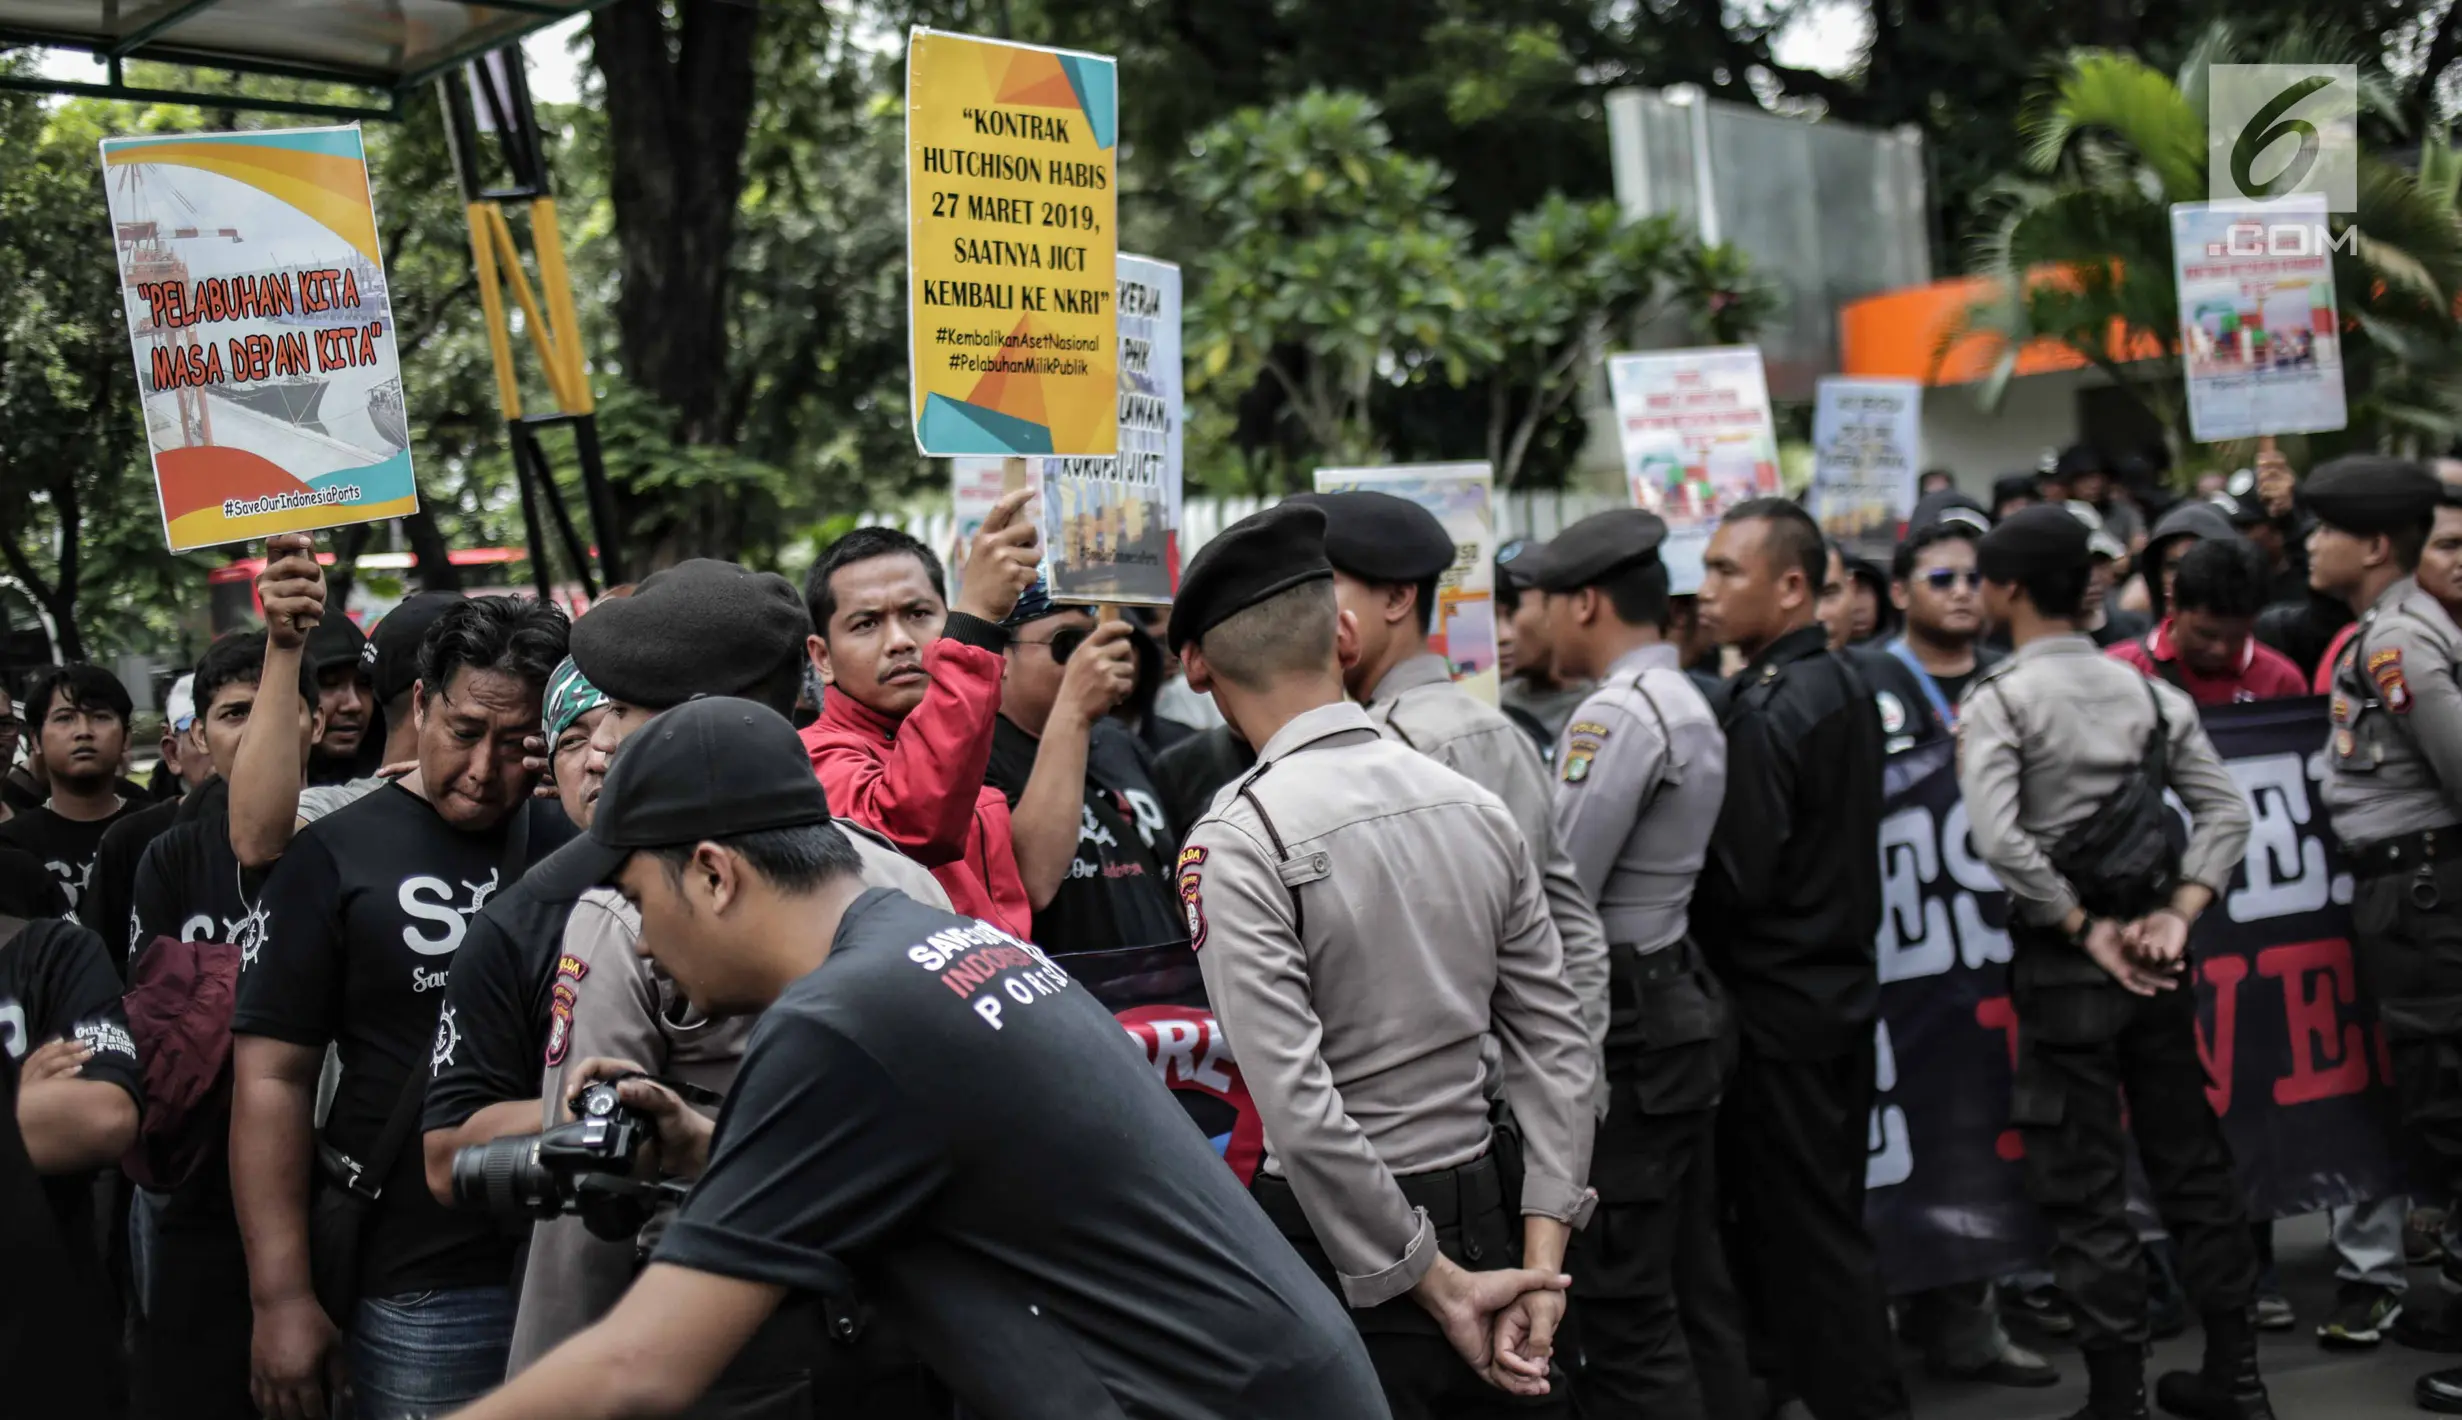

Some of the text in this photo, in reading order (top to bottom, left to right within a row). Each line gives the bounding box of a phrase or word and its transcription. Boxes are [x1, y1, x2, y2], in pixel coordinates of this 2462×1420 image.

[962, 108, 1070, 144] “KONTRAK
[923, 146, 1107, 190] HUTCHISON HABIS
[932, 190, 1101, 236] 27 MARET 2019,
[954, 236, 1088, 272] SAATNYA JICT
[138, 267, 361, 329] "PELABUHAN KITA
[923, 279, 1110, 315] KEMBALI KE NKRI”
[151, 321, 383, 392] MASA DEPAN KITA"
[935, 326, 1100, 353] #KembalikanAsetNasional
[948, 353, 1089, 377] #PelabuhanMilikPublik
[223, 484, 362, 519] #SaveOurIndonesiaPorts
